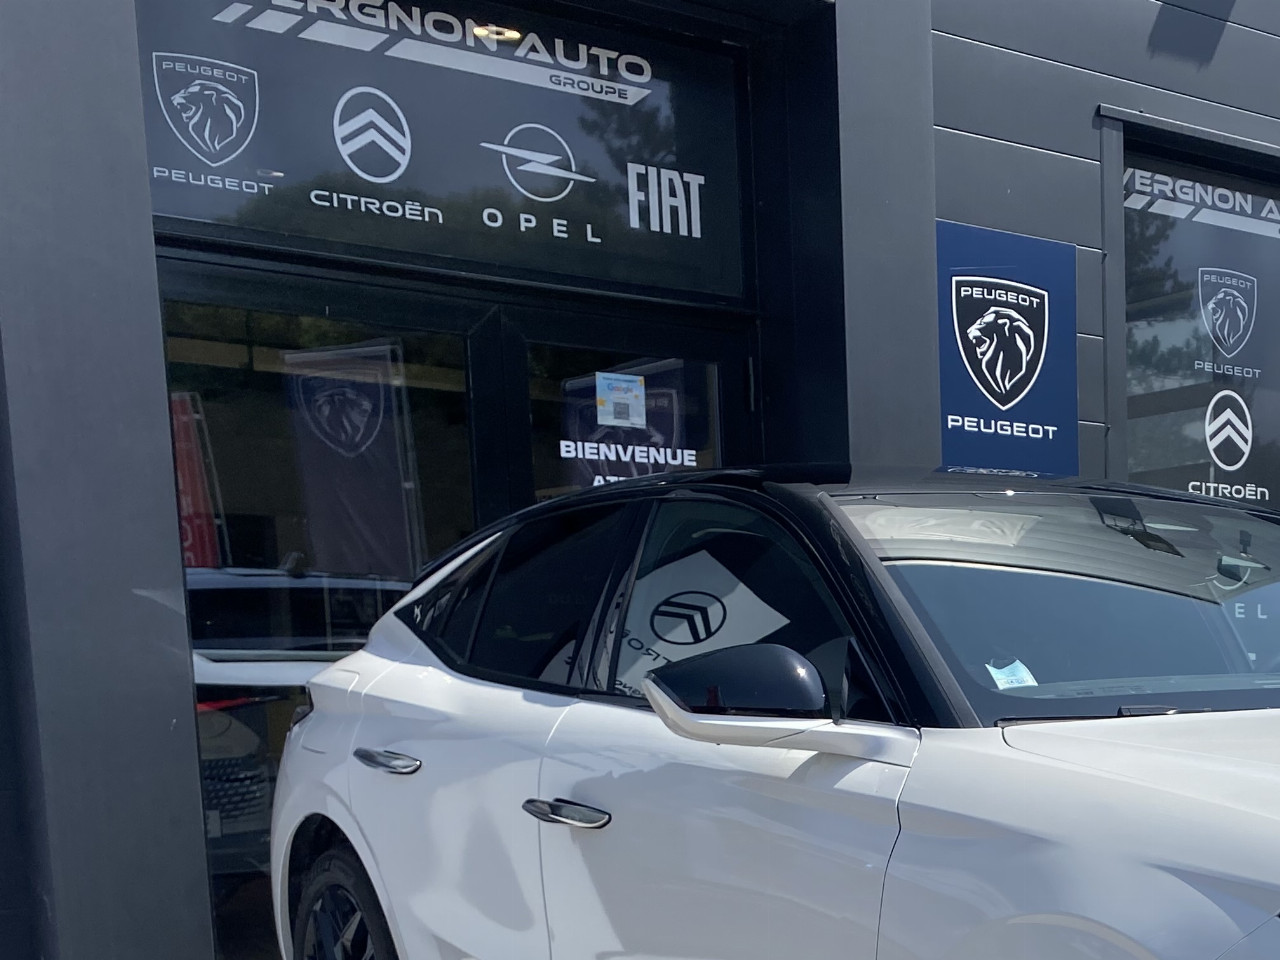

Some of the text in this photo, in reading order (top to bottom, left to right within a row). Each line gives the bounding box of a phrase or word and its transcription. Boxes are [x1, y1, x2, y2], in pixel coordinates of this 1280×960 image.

[272, 0, 652, 83] RGNON AUTO
[162, 61, 249, 84] PEUGEOT
[549, 74, 629, 100] GROUPE
[153, 166, 274, 195] PEUGEOT
[309, 189, 443, 224] CITROËN
[626, 162, 706, 239] FIAT
[482, 208, 601, 243] OPEL
[1203, 273, 1252, 290] PEUGEOT
[960, 285, 1041, 308] PEUGEOT
[1194, 360, 1262, 379] PEUGEOT
[947, 414, 1058, 440] PEUGEOT
[559, 439, 697, 467] BIENVENUE
[1188, 481, 1269, 500] CITROËN
